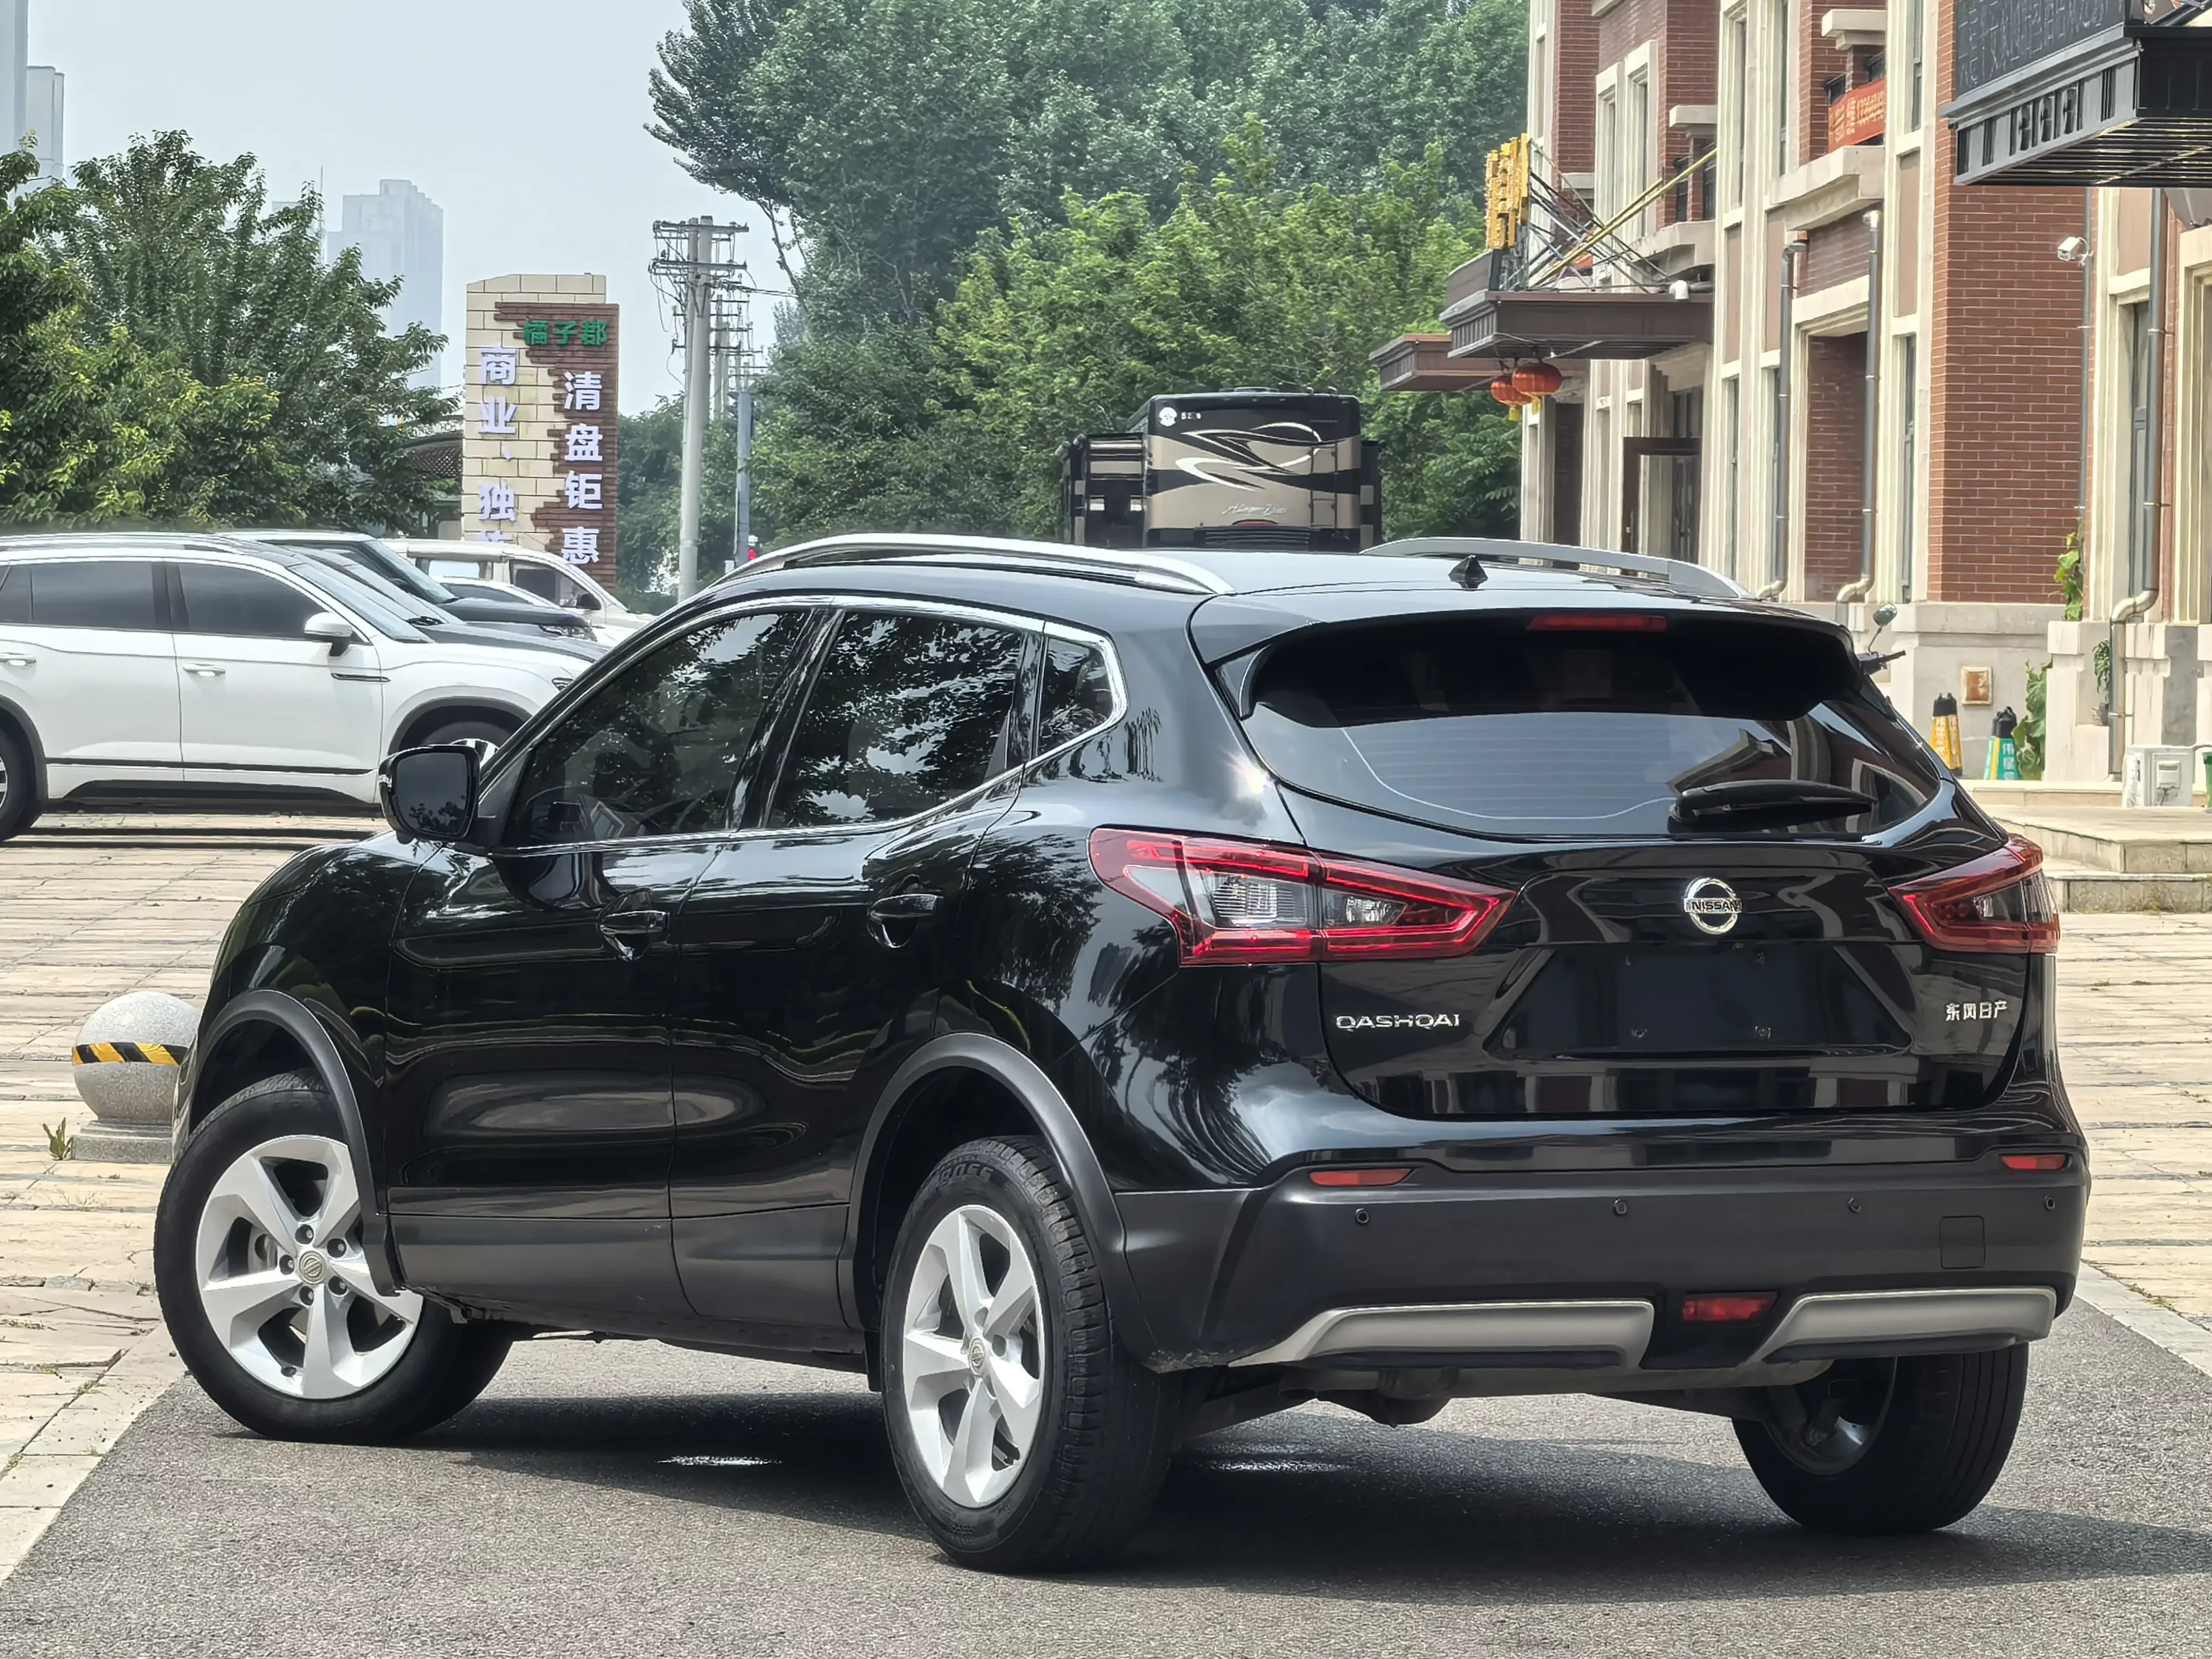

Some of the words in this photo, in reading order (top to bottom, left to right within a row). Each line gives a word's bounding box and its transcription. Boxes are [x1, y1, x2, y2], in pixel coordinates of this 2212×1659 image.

[561, 371, 603, 565] 清盘钜惠
[1692, 901, 1740, 911] NISSAN
[1945, 1000, 2008, 1022] 东风日产
[1335, 1013, 1460, 1032] QASHQAI
